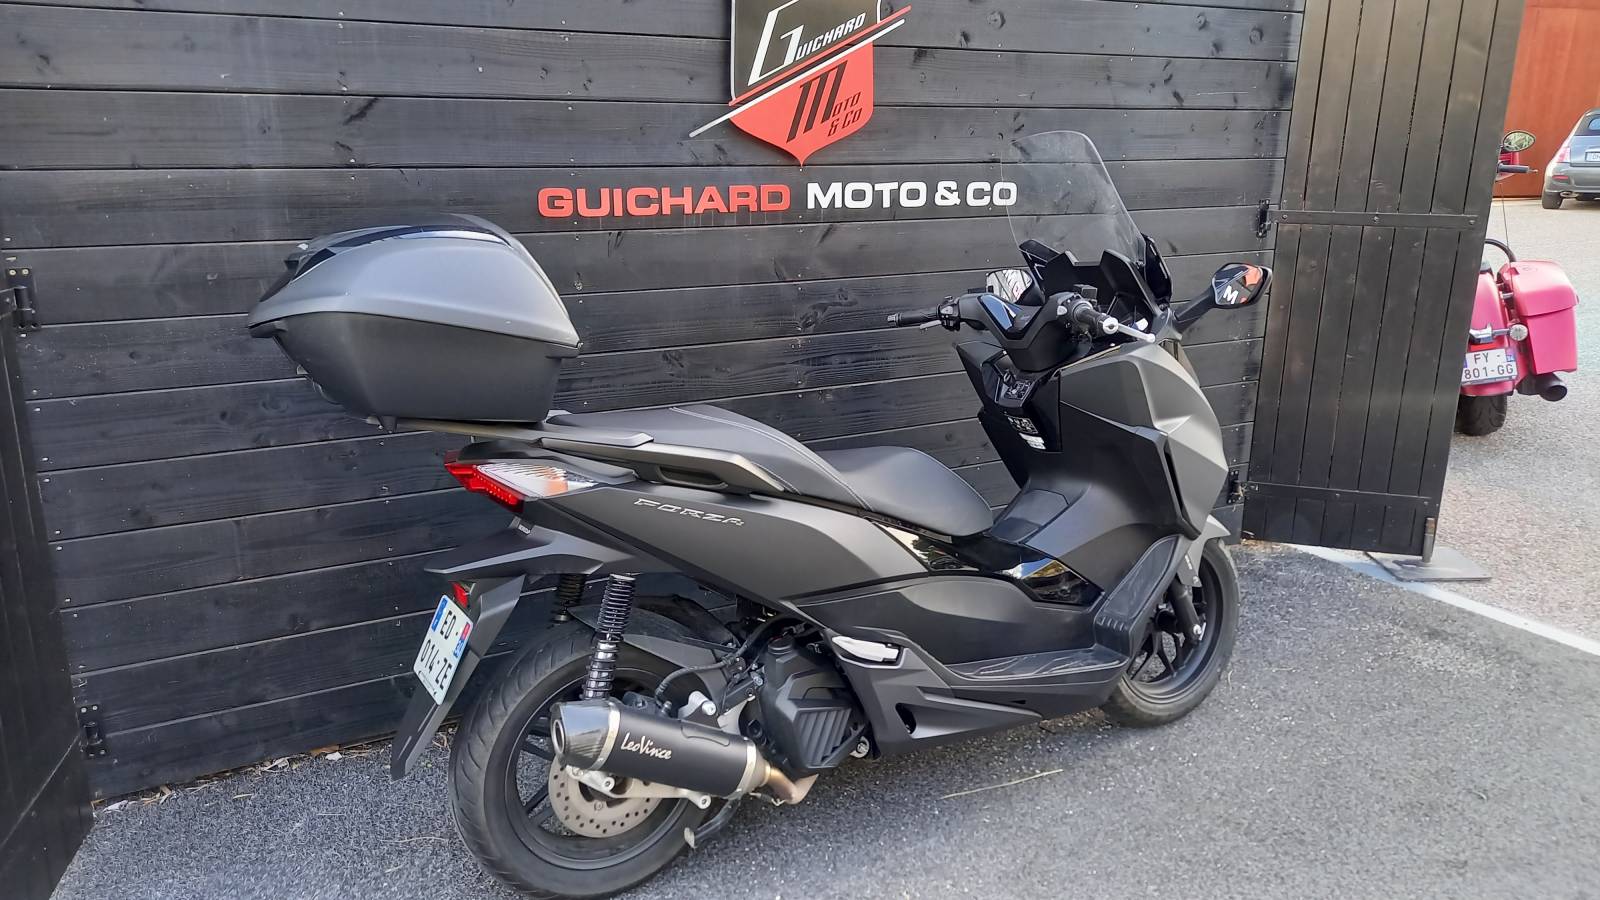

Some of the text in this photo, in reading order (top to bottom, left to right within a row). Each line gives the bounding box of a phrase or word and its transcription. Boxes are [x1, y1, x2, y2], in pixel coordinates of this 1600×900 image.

[747, 0, 866, 87] GUICHARD
[537, 180, 1018, 218] GUICHARD MOTO & CO
[1464, 363, 1514, 380] 801-GG
[633, 498, 745, 526] FORZA
[620, 731, 672, 760] LeoVince
